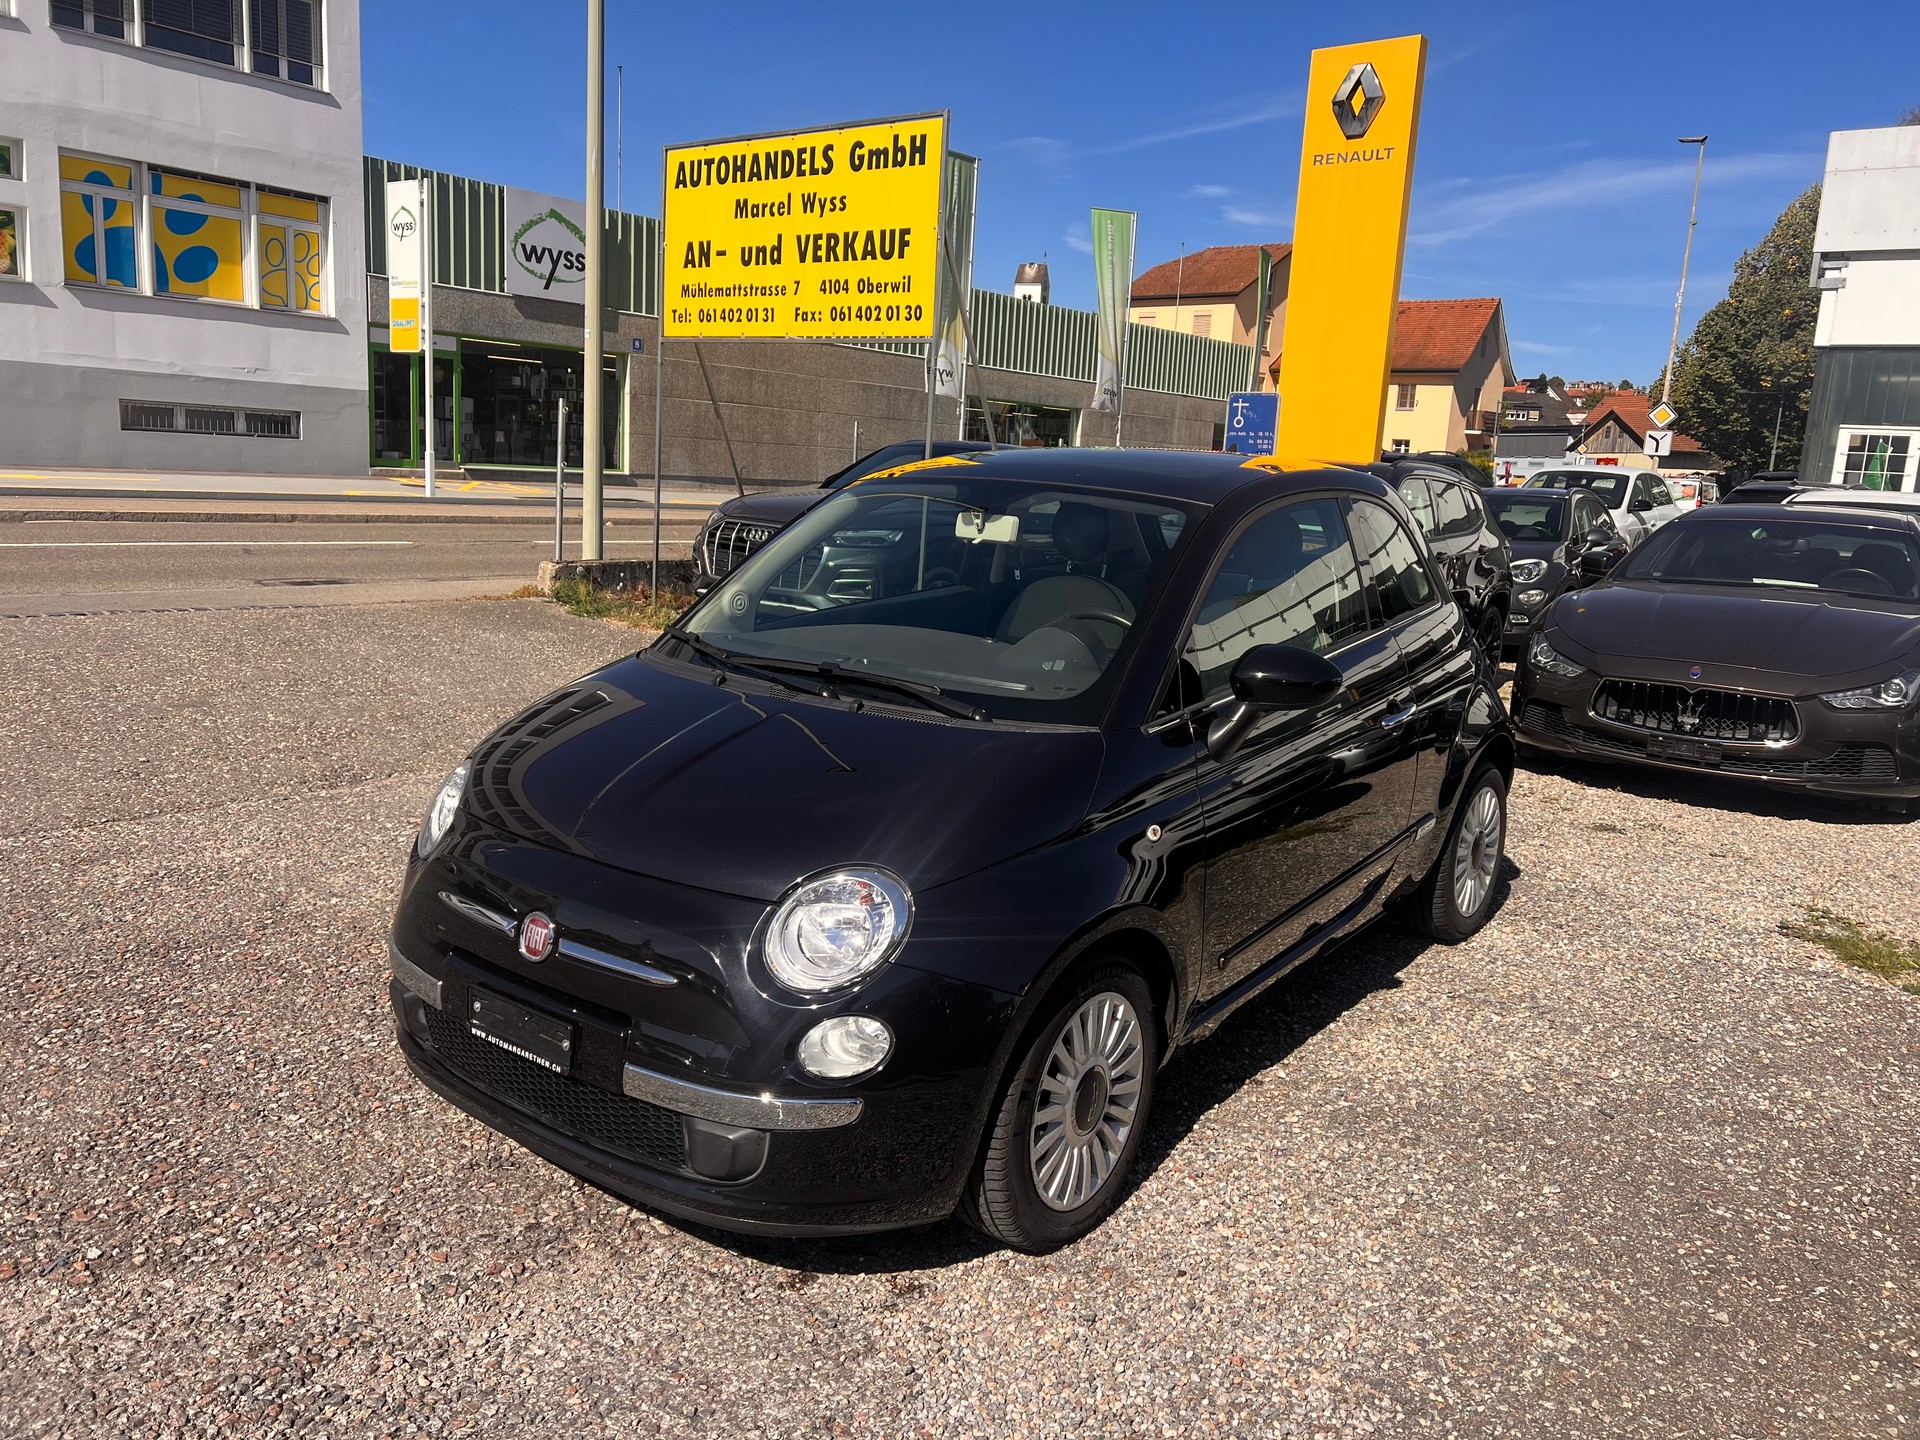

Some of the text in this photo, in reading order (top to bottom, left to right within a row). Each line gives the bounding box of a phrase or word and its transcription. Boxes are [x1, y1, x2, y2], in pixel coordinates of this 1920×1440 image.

[674, 133, 927, 189] AUTOHANDELS GmbH
[1313, 147, 1395, 166] RENAULT
[734, 191, 847, 219] Marcel Wyss
[740, 233, 782, 266] und
[796, 227, 911, 264] VERKAUF
[520, 242, 586, 290] wyss
[681, 275, 911, 298] Mühlemattstrasse 7 4104 Oberwil
[671, 308, 692, 323] Tel:
[794, 306, 822, 322] Fax:
[633, 339, 641, 348] 8
[525, 922, 548, 951] FIAT
[471, 1027, 562, 1074] WWW.AUTOMARGARETHEN.CH
